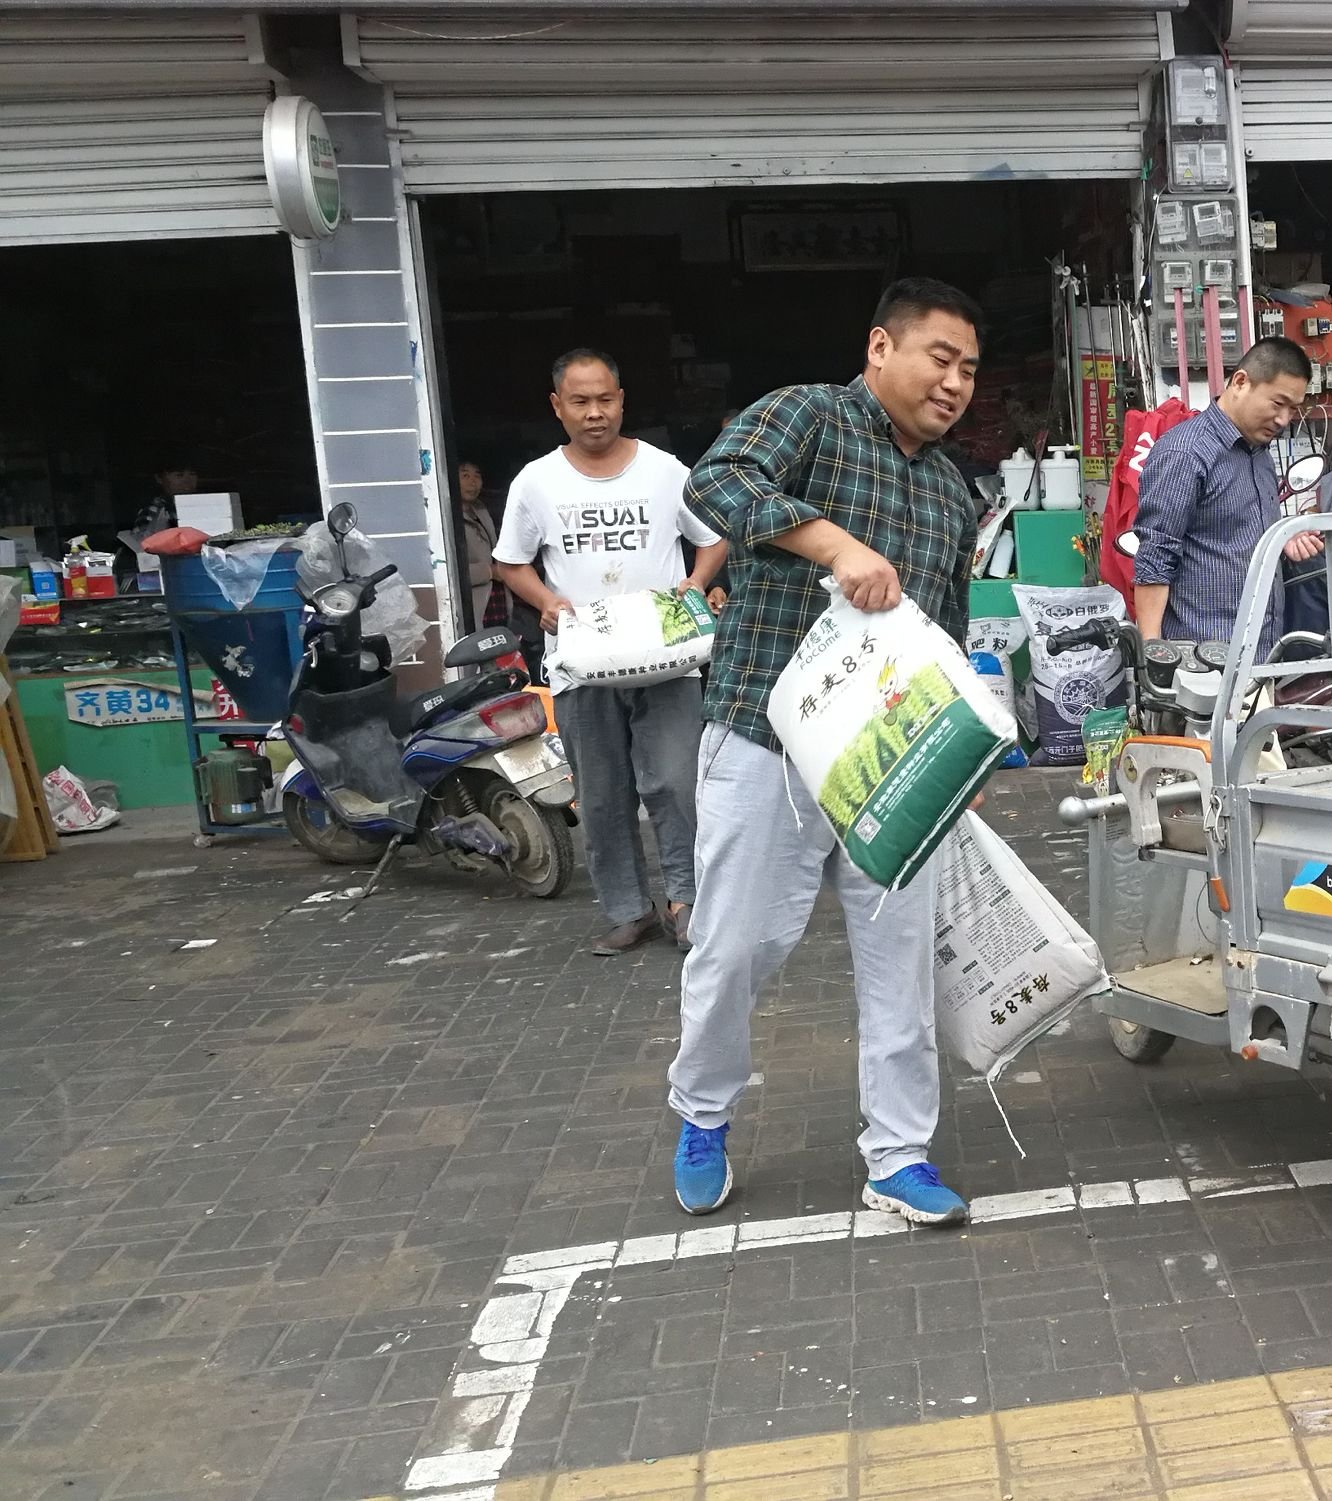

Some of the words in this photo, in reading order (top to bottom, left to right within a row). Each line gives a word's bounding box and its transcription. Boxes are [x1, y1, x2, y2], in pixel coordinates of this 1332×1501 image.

[580, 500, 613, 509] EFFECTS
[614, 498, 649, 506] DESIGNER
[558, 505, 650, 529] VISUAL
[562, 529, 650, 554] EFFECT
[477, 634, 507, 652] 爱玛
[799, 630, 843, 671] FOCOME
[75, 689, 171, 718] 齐黄34
[422, 695, 445, 713] 爱玛
[989, 972, 1051, 1026] 存麦8号
